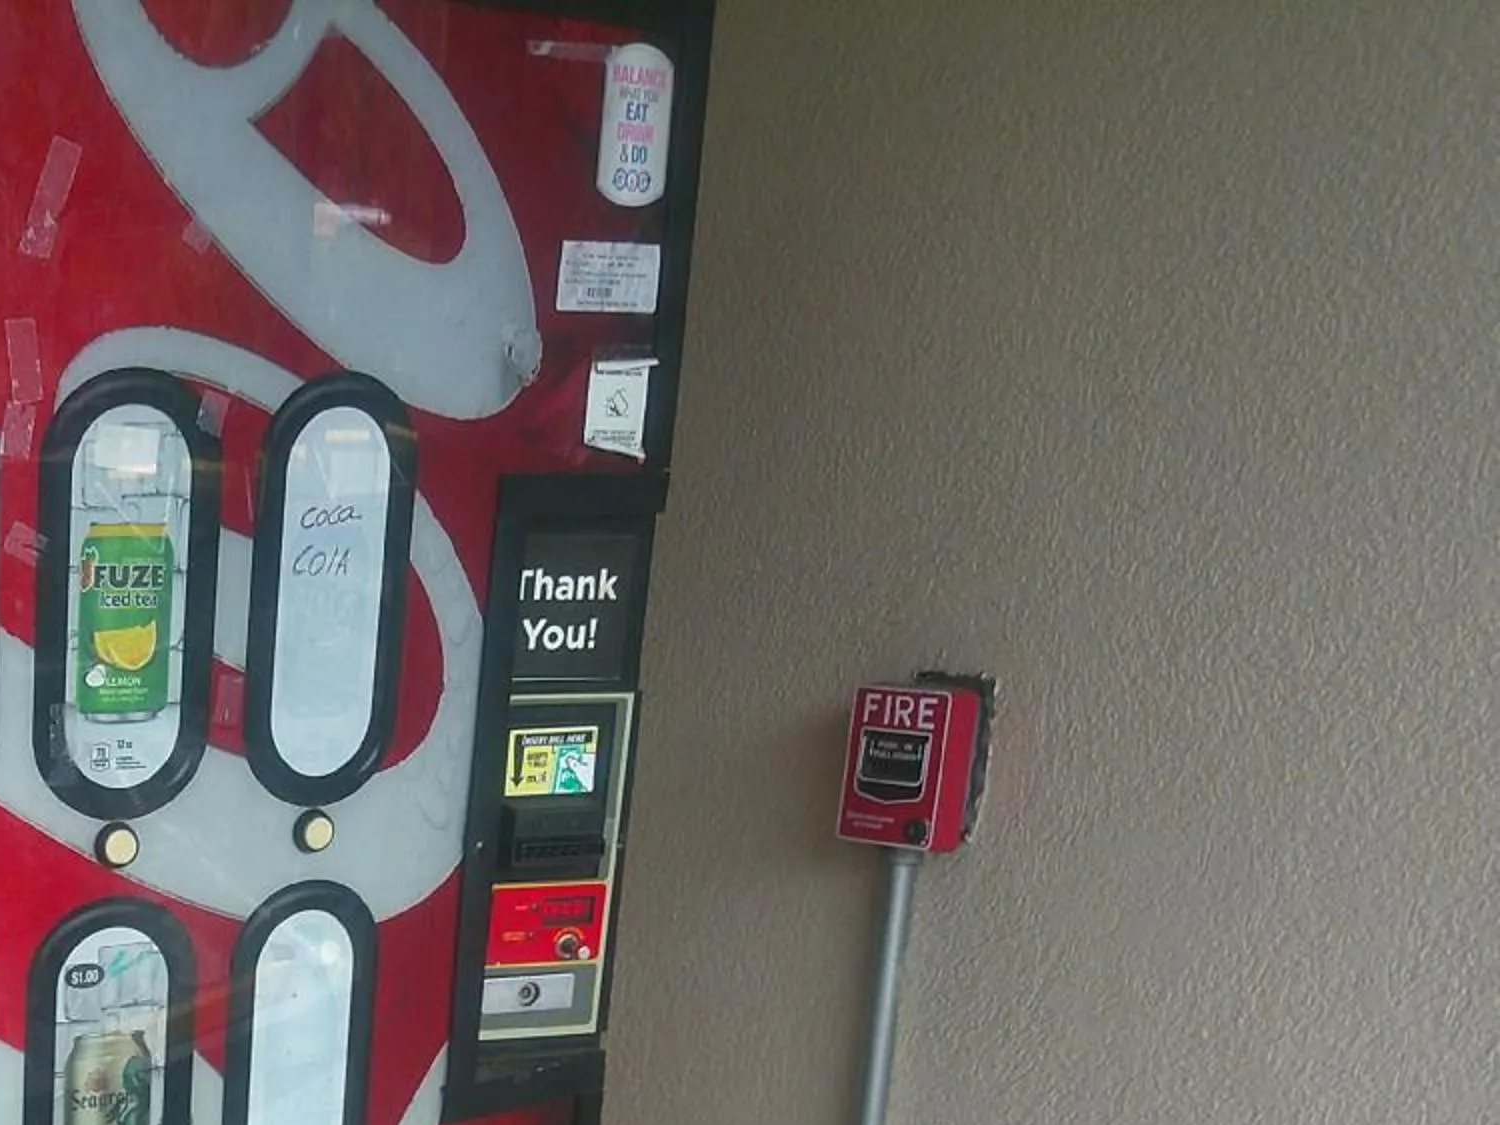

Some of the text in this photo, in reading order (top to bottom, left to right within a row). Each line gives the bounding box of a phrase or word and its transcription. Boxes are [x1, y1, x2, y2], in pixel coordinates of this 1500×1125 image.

[613, 64, 667, 88] BALANCE
[626, 103, 649, 122] EAT
[631, 146, 648, 164] DO
[94, 564, 164, 590] FUZE
[519, 568, 619, 601] Thank
[522, 618, 599, 650] You!
[862, 693, 939, 730] FIRE
[71, 970, 100, 985] $1.00
